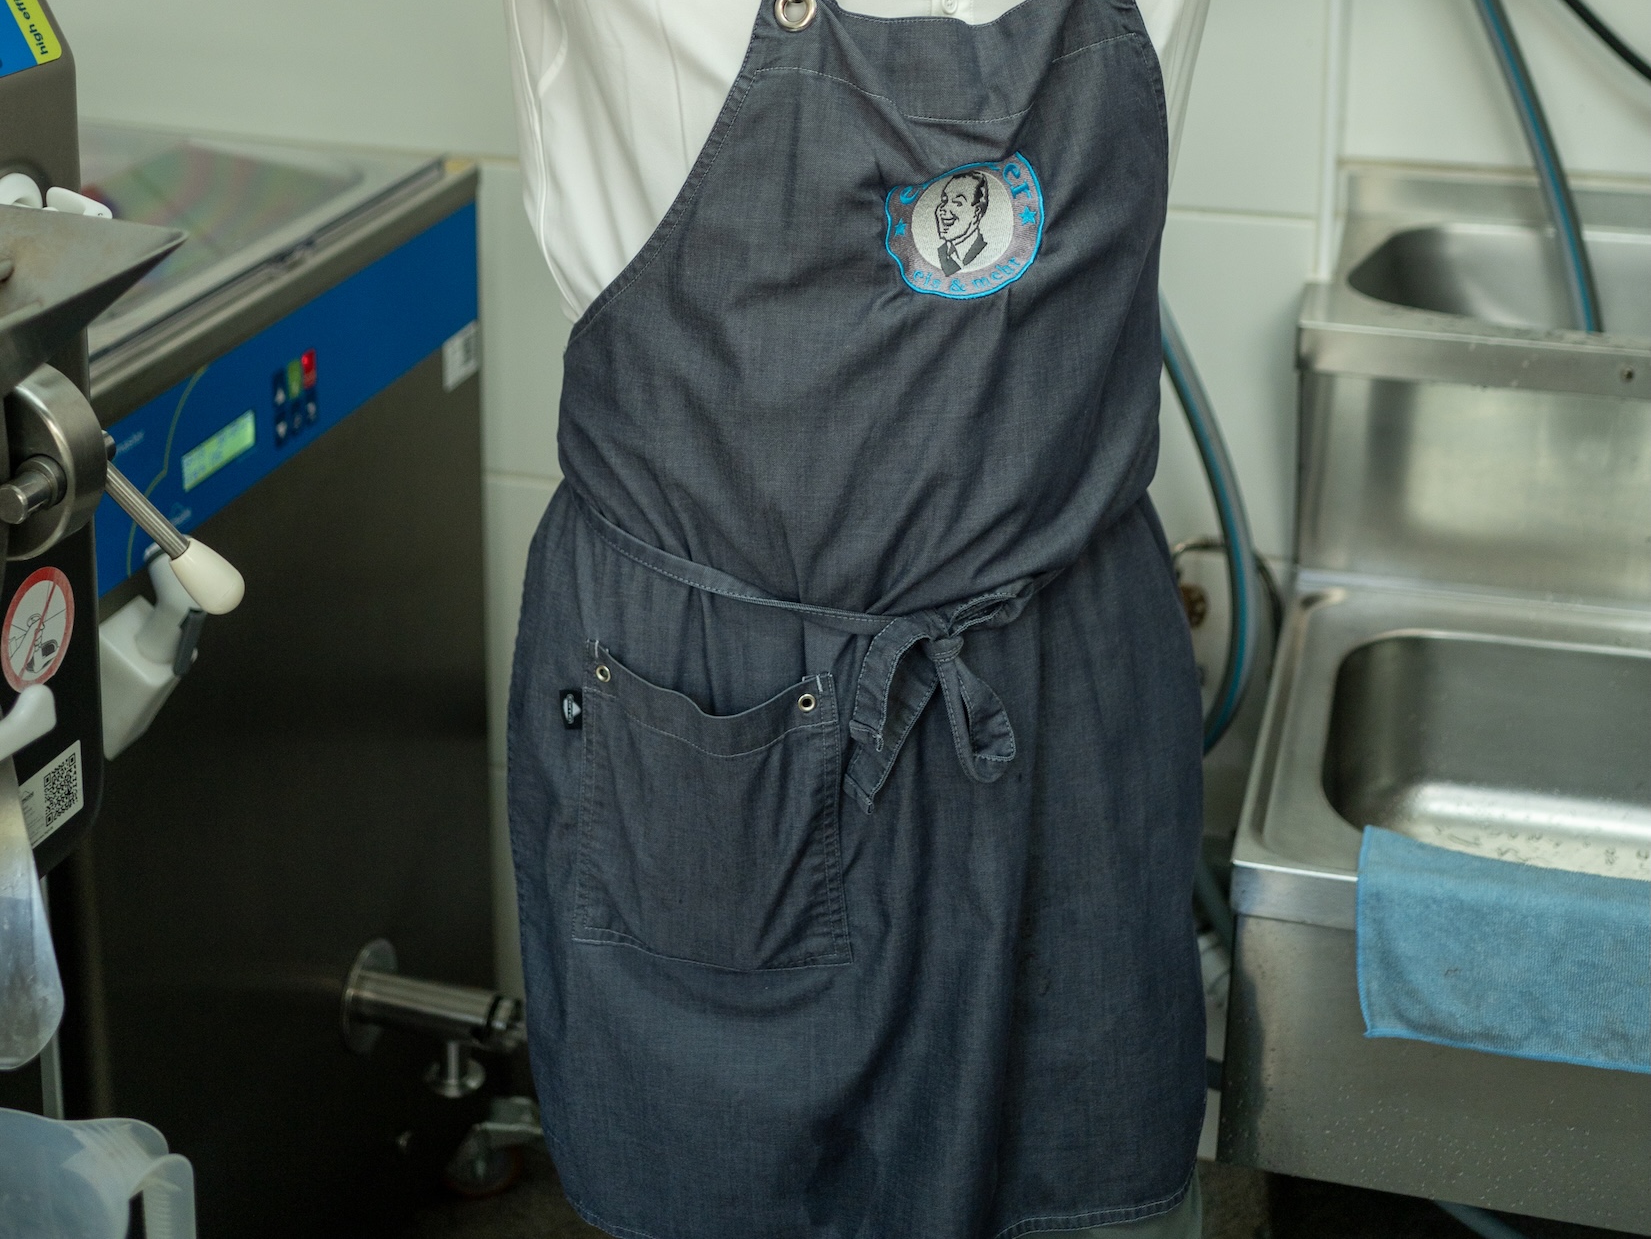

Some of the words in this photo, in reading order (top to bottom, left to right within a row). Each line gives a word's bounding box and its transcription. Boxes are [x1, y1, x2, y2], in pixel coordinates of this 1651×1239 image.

[29, 23, 48, 55] high
[912, 269, 942, 289] eis
[949, 277, 967, 292] &
[971, 256, 1021, 290] mehr
